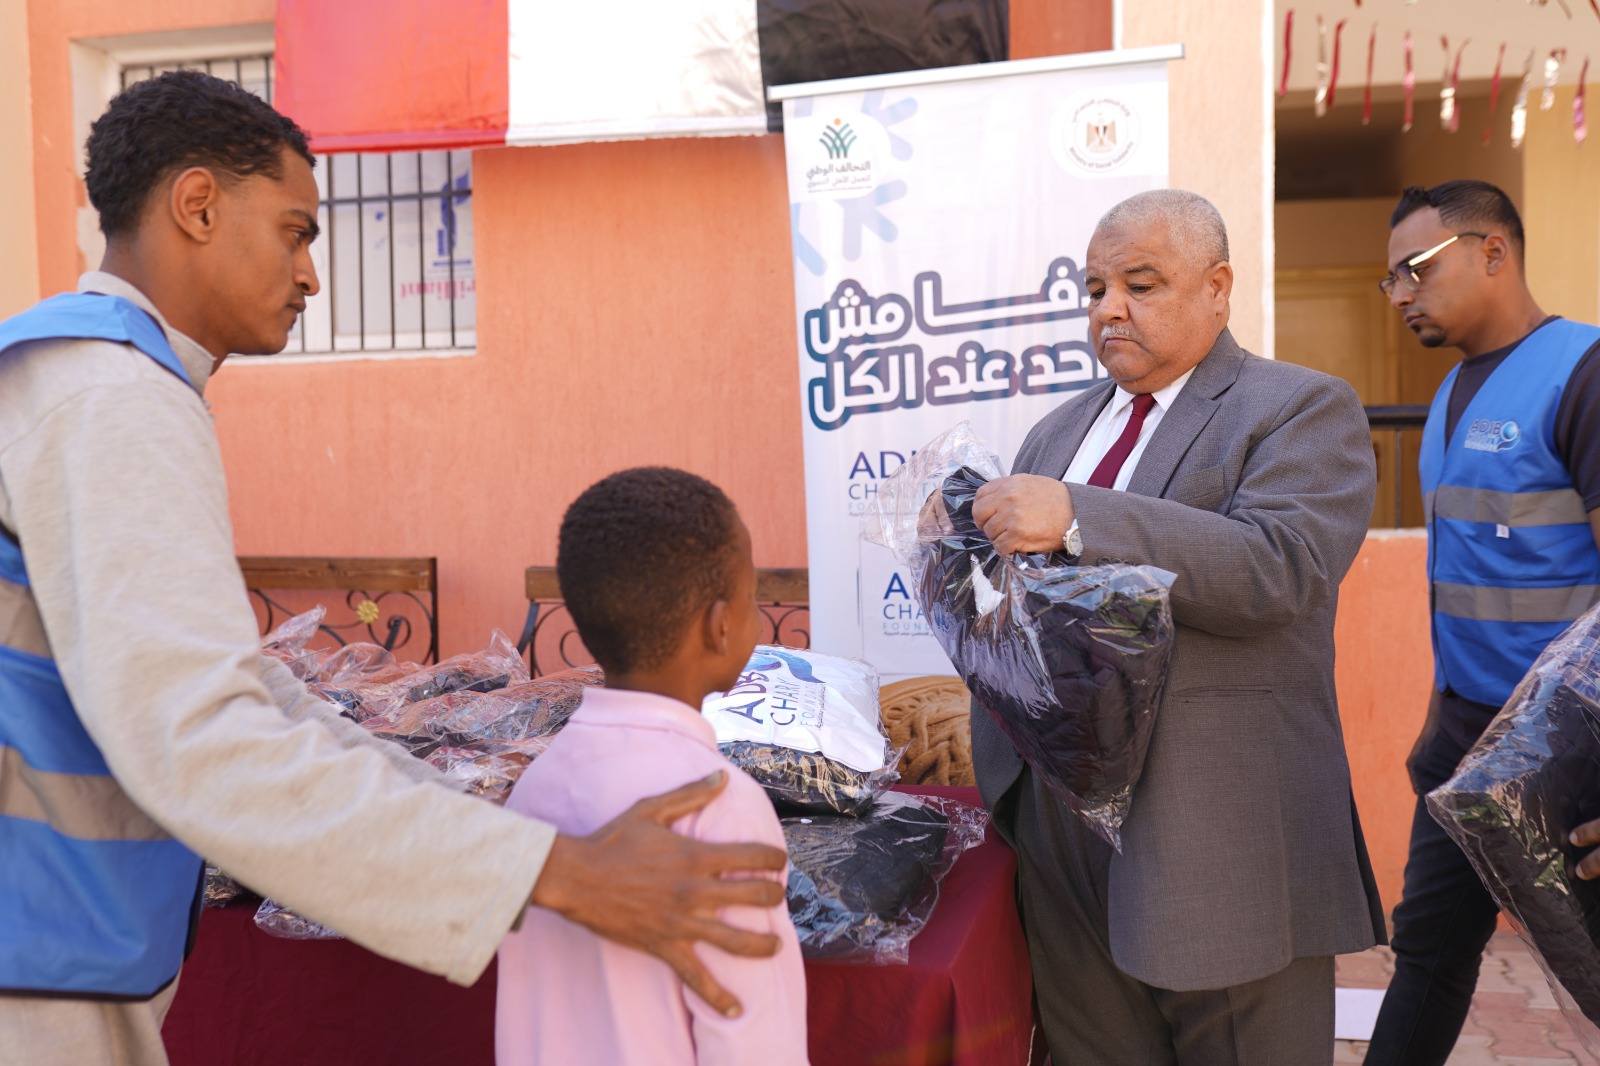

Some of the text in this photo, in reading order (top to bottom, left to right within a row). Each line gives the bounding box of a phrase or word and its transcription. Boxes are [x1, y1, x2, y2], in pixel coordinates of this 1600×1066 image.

[805, 279, 913, 361] مش
[809, 345, 924, 430] الكل
[927, 342, 1018, 405] عند
